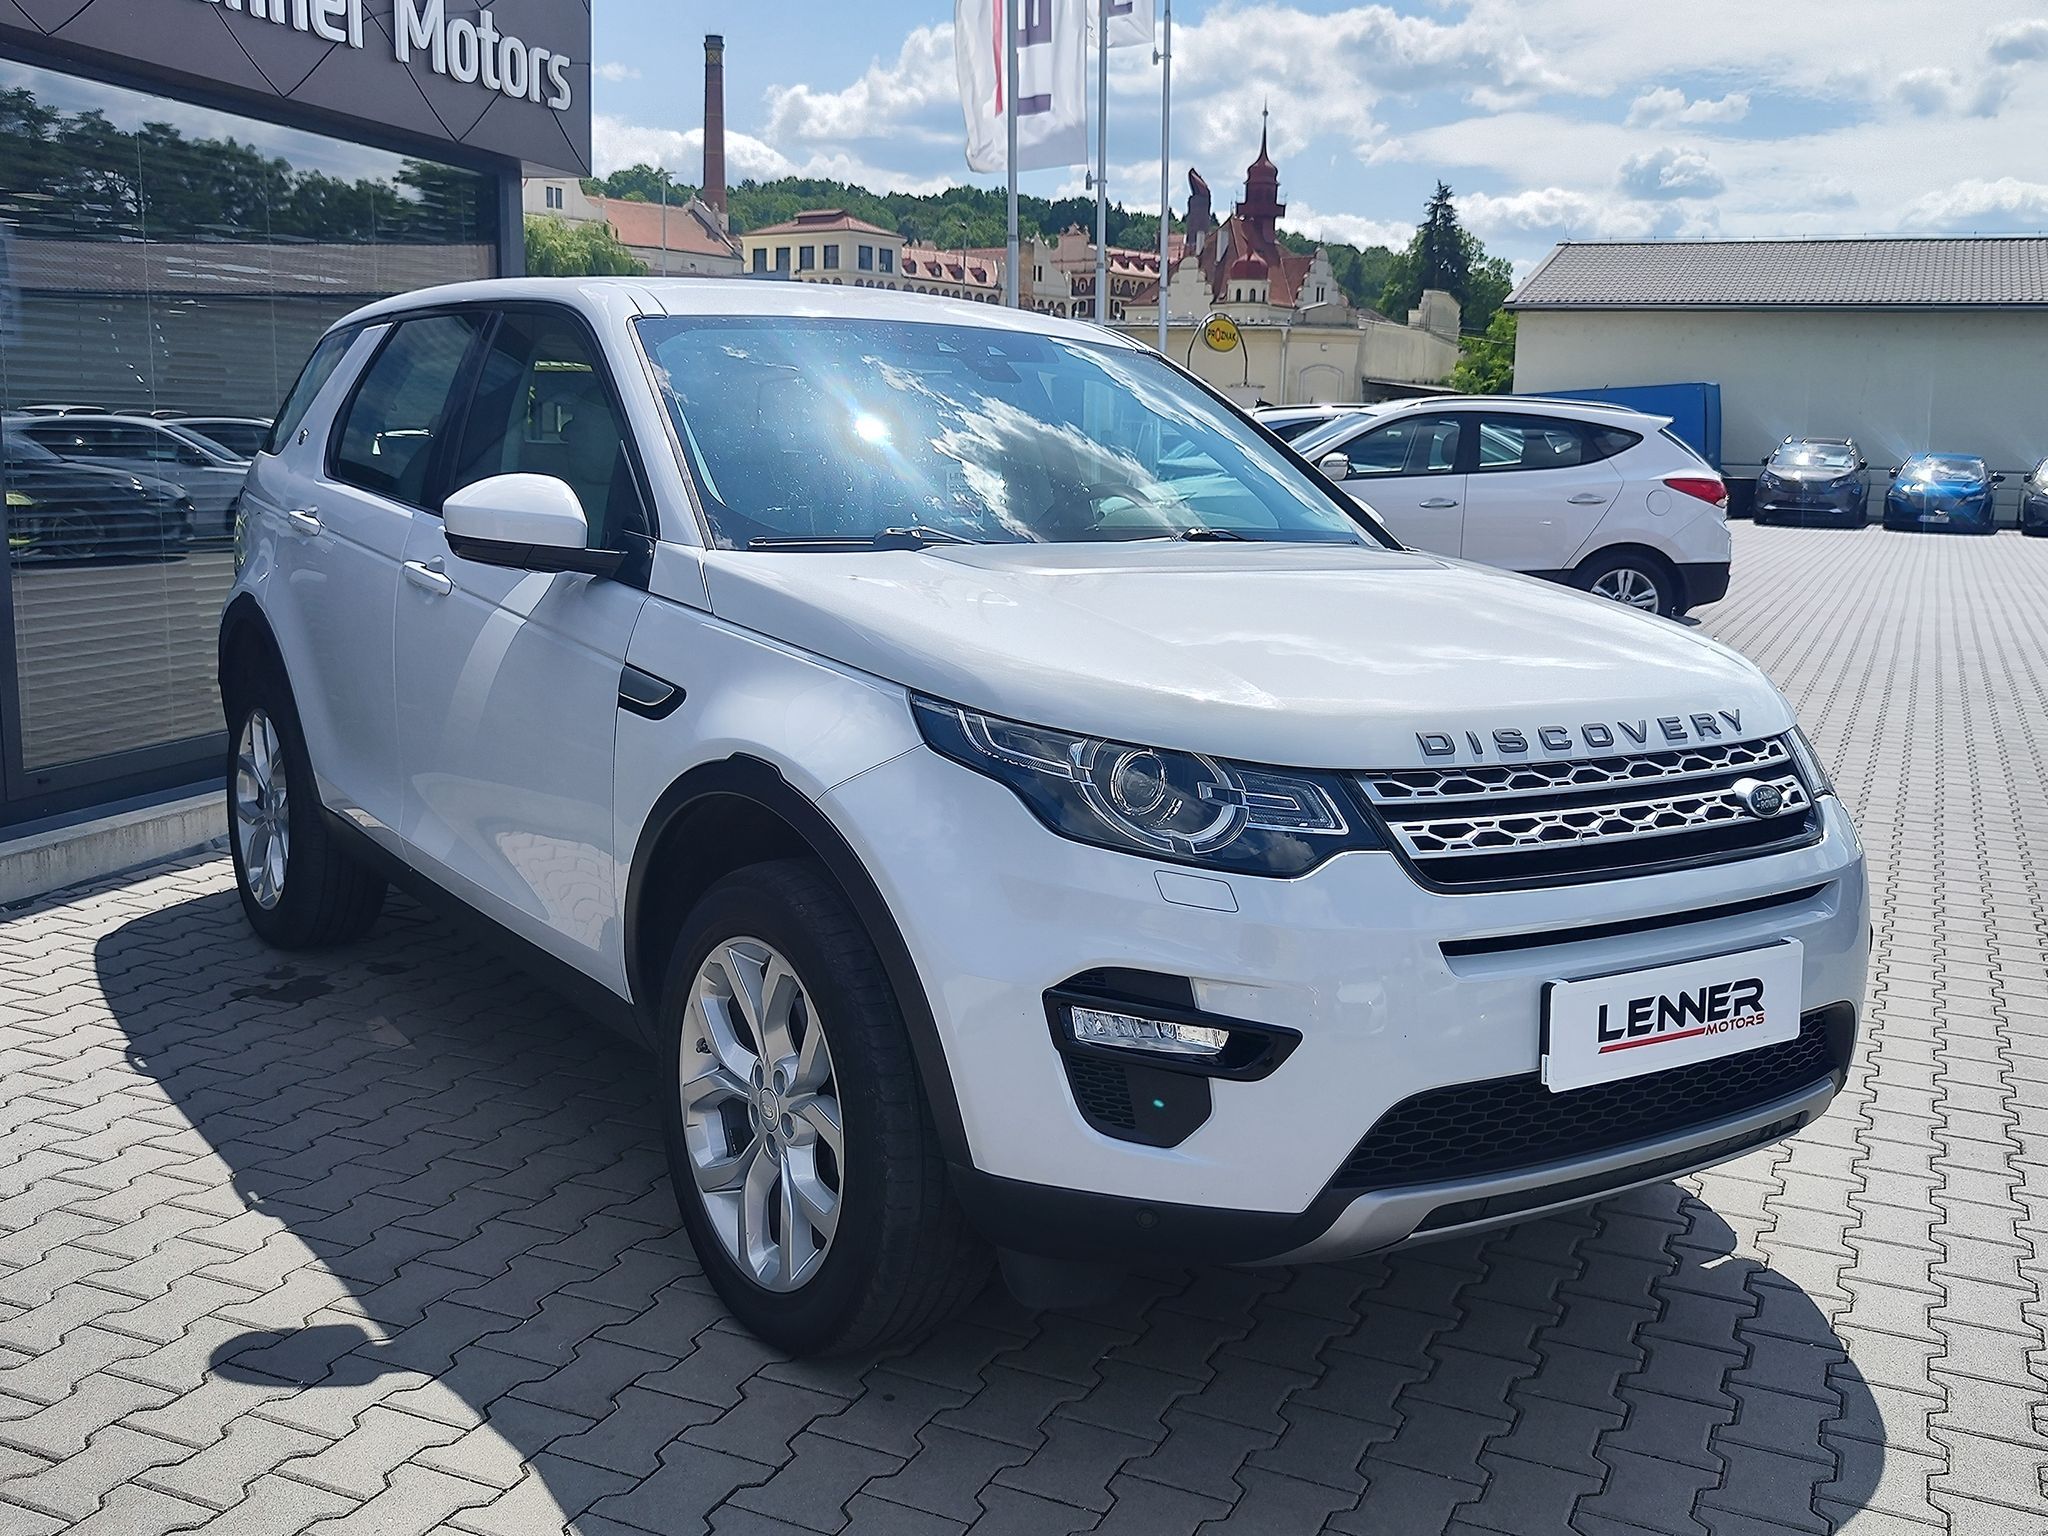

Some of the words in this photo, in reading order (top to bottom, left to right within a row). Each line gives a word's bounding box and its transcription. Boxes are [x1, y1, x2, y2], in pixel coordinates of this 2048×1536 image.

[394, 0, 572, 111] Motors
[1415, 708, 1743, 756] DISCOVERY
[1755, 790, 1776, 801] LAND
[1597, 977, 1765, 1043] LENNER
[1705, 1013, 1765, 1036] MOTORS
